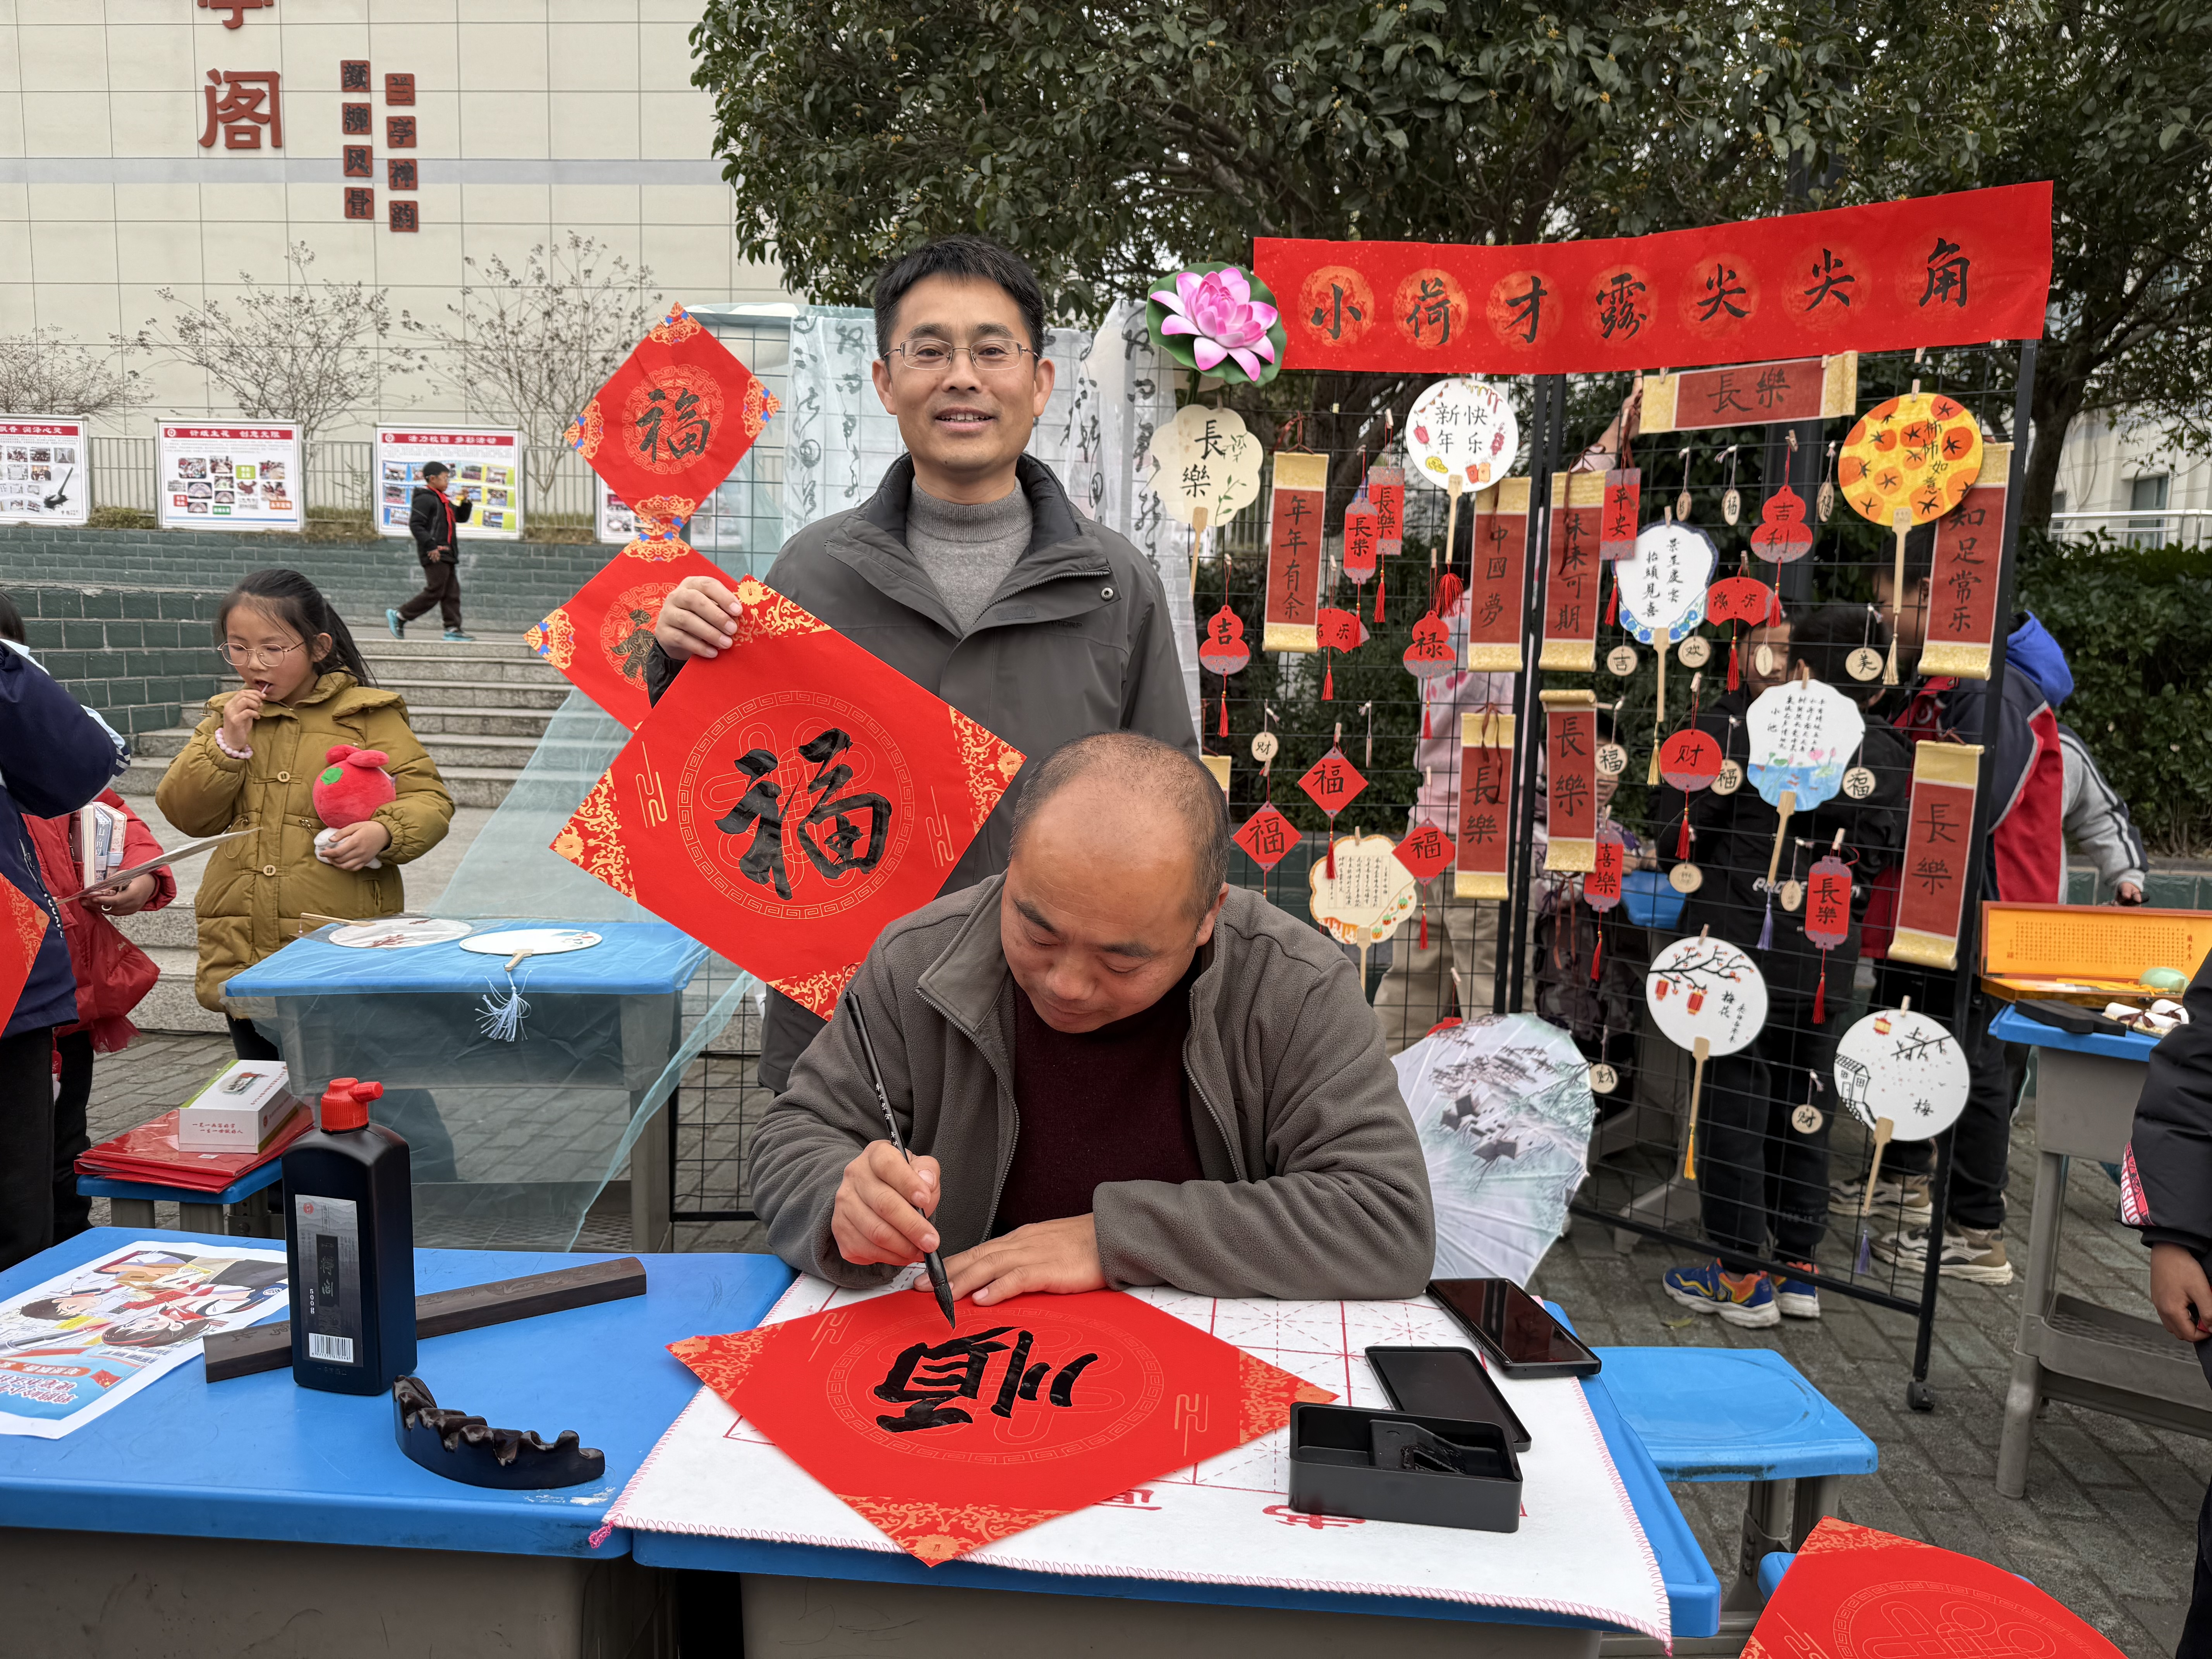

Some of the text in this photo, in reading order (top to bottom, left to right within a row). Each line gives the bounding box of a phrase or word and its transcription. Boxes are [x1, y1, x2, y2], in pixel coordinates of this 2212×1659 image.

[389, 77, 415, 229] 兰亭神韵
[1310, 237, 1972, 345] 小荷才露尖尖角
[1707, 367, 1791, 414] 長樂
[408, 435, 497, 444] 活力校园 多彩活动
[635, 388, 711, 463] 福
[1435, 403, 1460, 454] 新年
[1464, 405, 1488, 454] 快乐
[1180, 419, 1224, 498] 長樂
[1922, 419, 1949, 494] 柿柿如意
[1348, 517, 1372, 557] 長樂
[1372, 487, 1395, 537] 長樂
[1609, 487, 1631, 537] 平安
[1766, 503, 1794, 554] 吉利
[1280, 495, 1312, 619] 年年有余
[1479, 526, 1509, 628] 中國夢
[1949, 505, 1985, 633] 知足常乐
[1217, 618, 1232, 645] 吉
[1613, 654, 1631, 671] 吉
[1313, 763, 1343, 795] 福
[1554, 716, 1589, 817] 長樂
[1599, 749, 1623, 773] 福
[1674, 744, 1704, 767] 财
[714, 727, 893, 901] 福
[1463, 766, 1506, 845] 長樂
[1246, 816, 1285, 855] 福
[1410, 831, 1441, 859] 福
[1911, 804, 1960, 895] 長樂
[1595, 843, 1617, 895] 喜樂
[1813, 878, 1842, 925] 長樂
